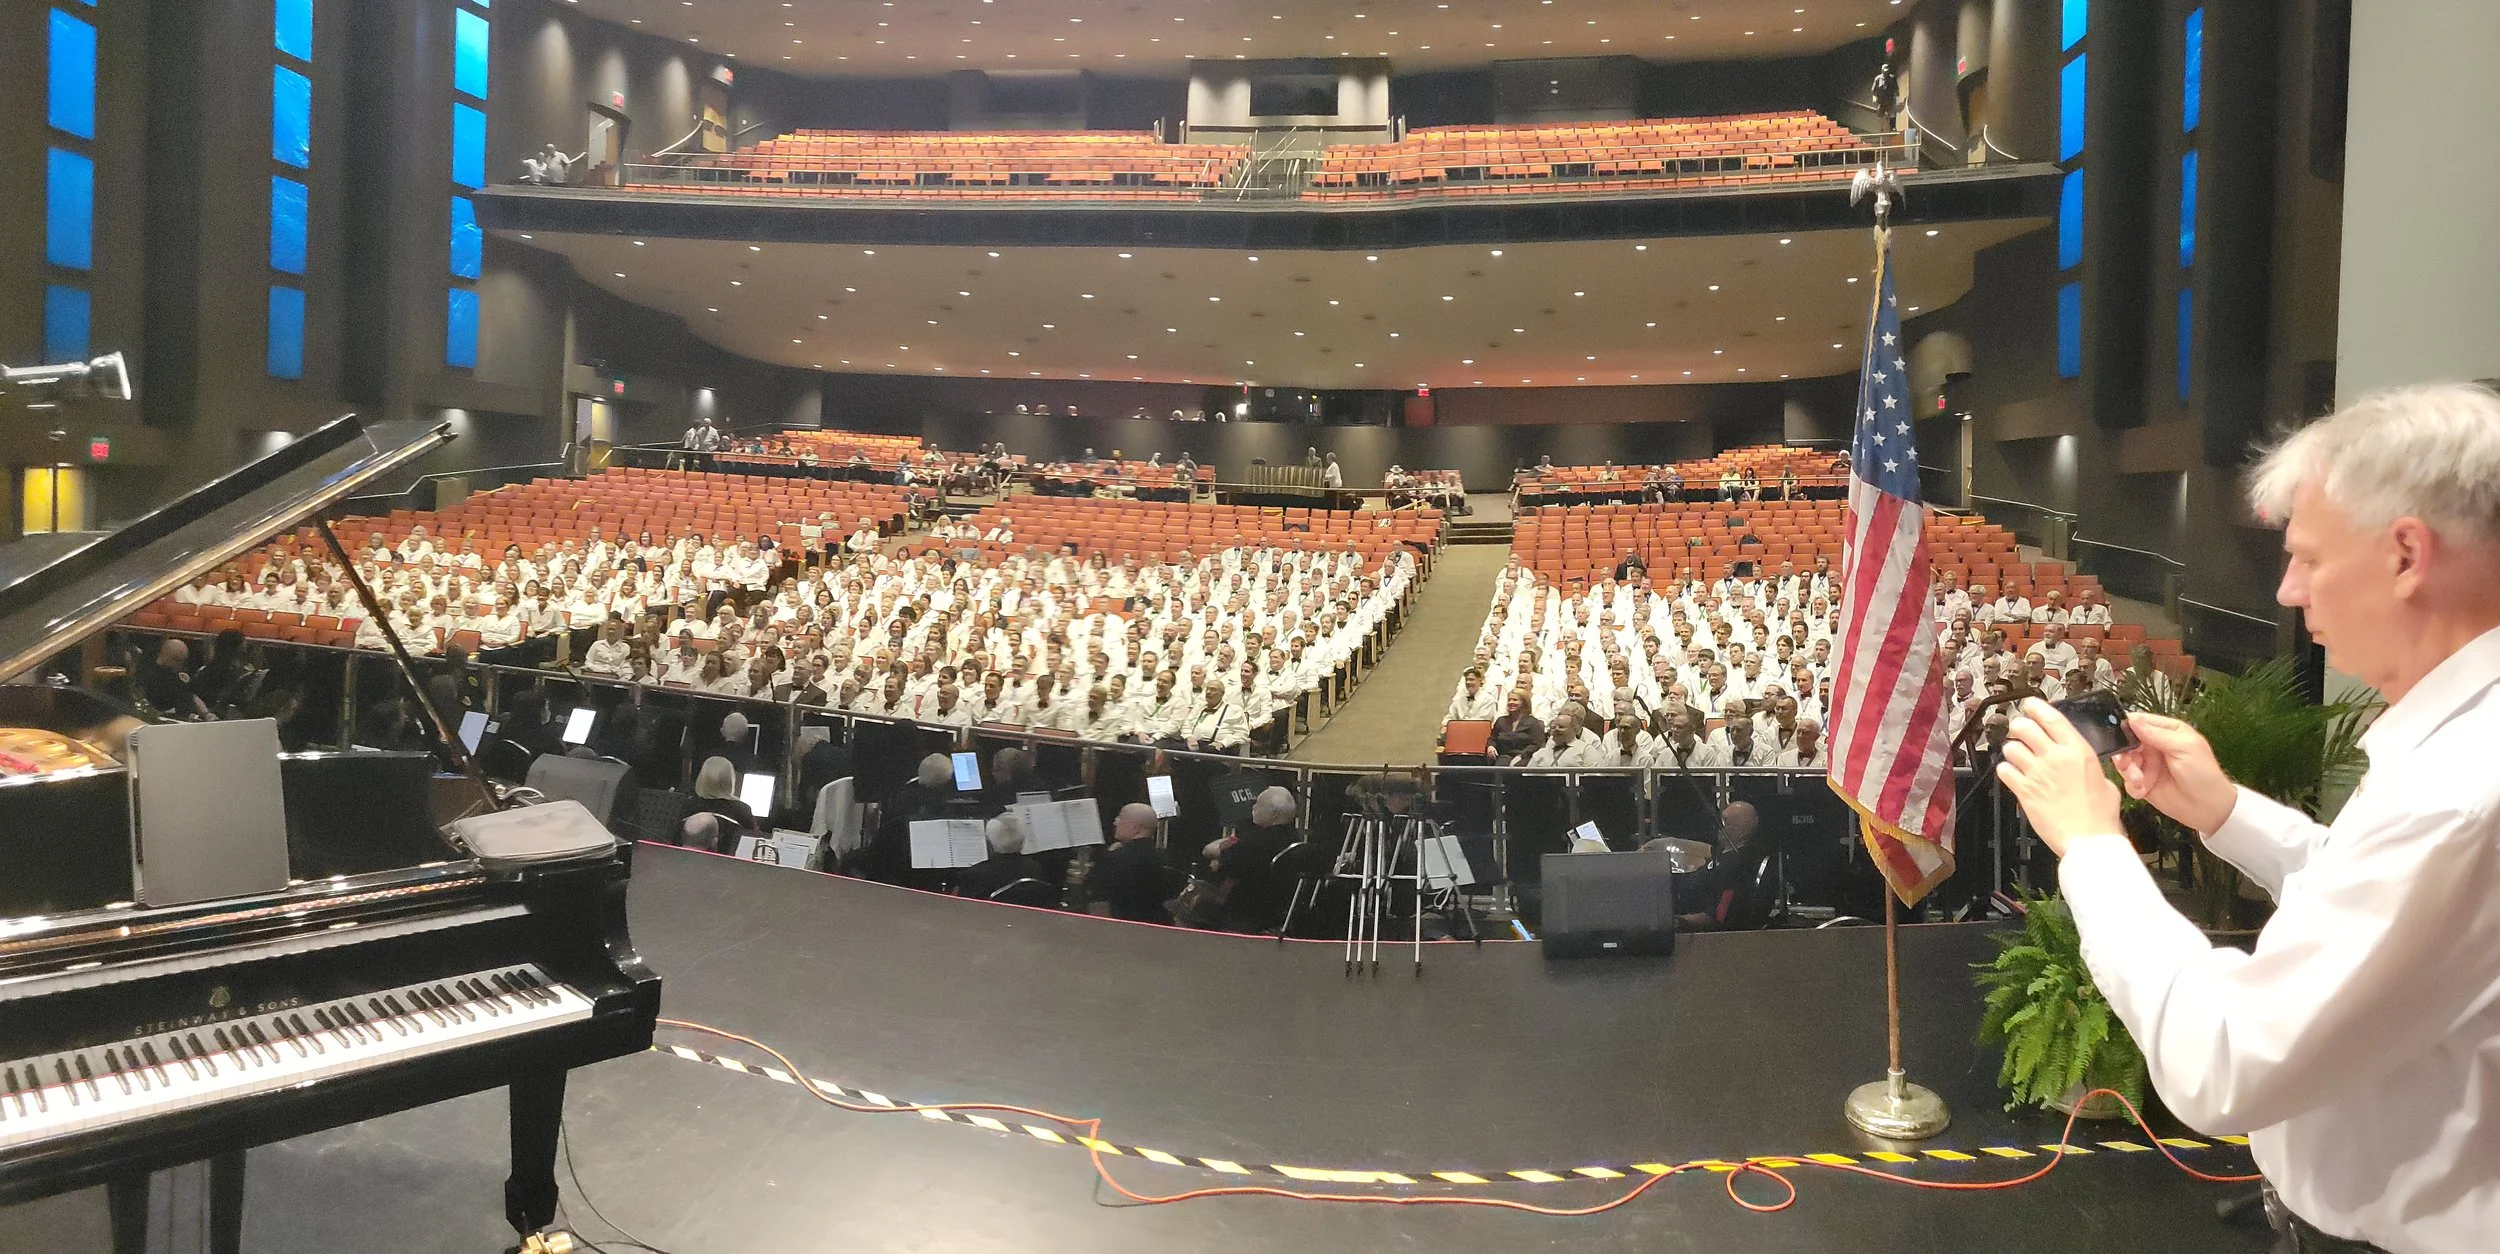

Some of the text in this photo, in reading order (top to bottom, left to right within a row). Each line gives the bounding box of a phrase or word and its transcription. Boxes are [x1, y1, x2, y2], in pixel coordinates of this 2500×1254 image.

[134, 997, 299, 1035] STEINWAY & SONS
